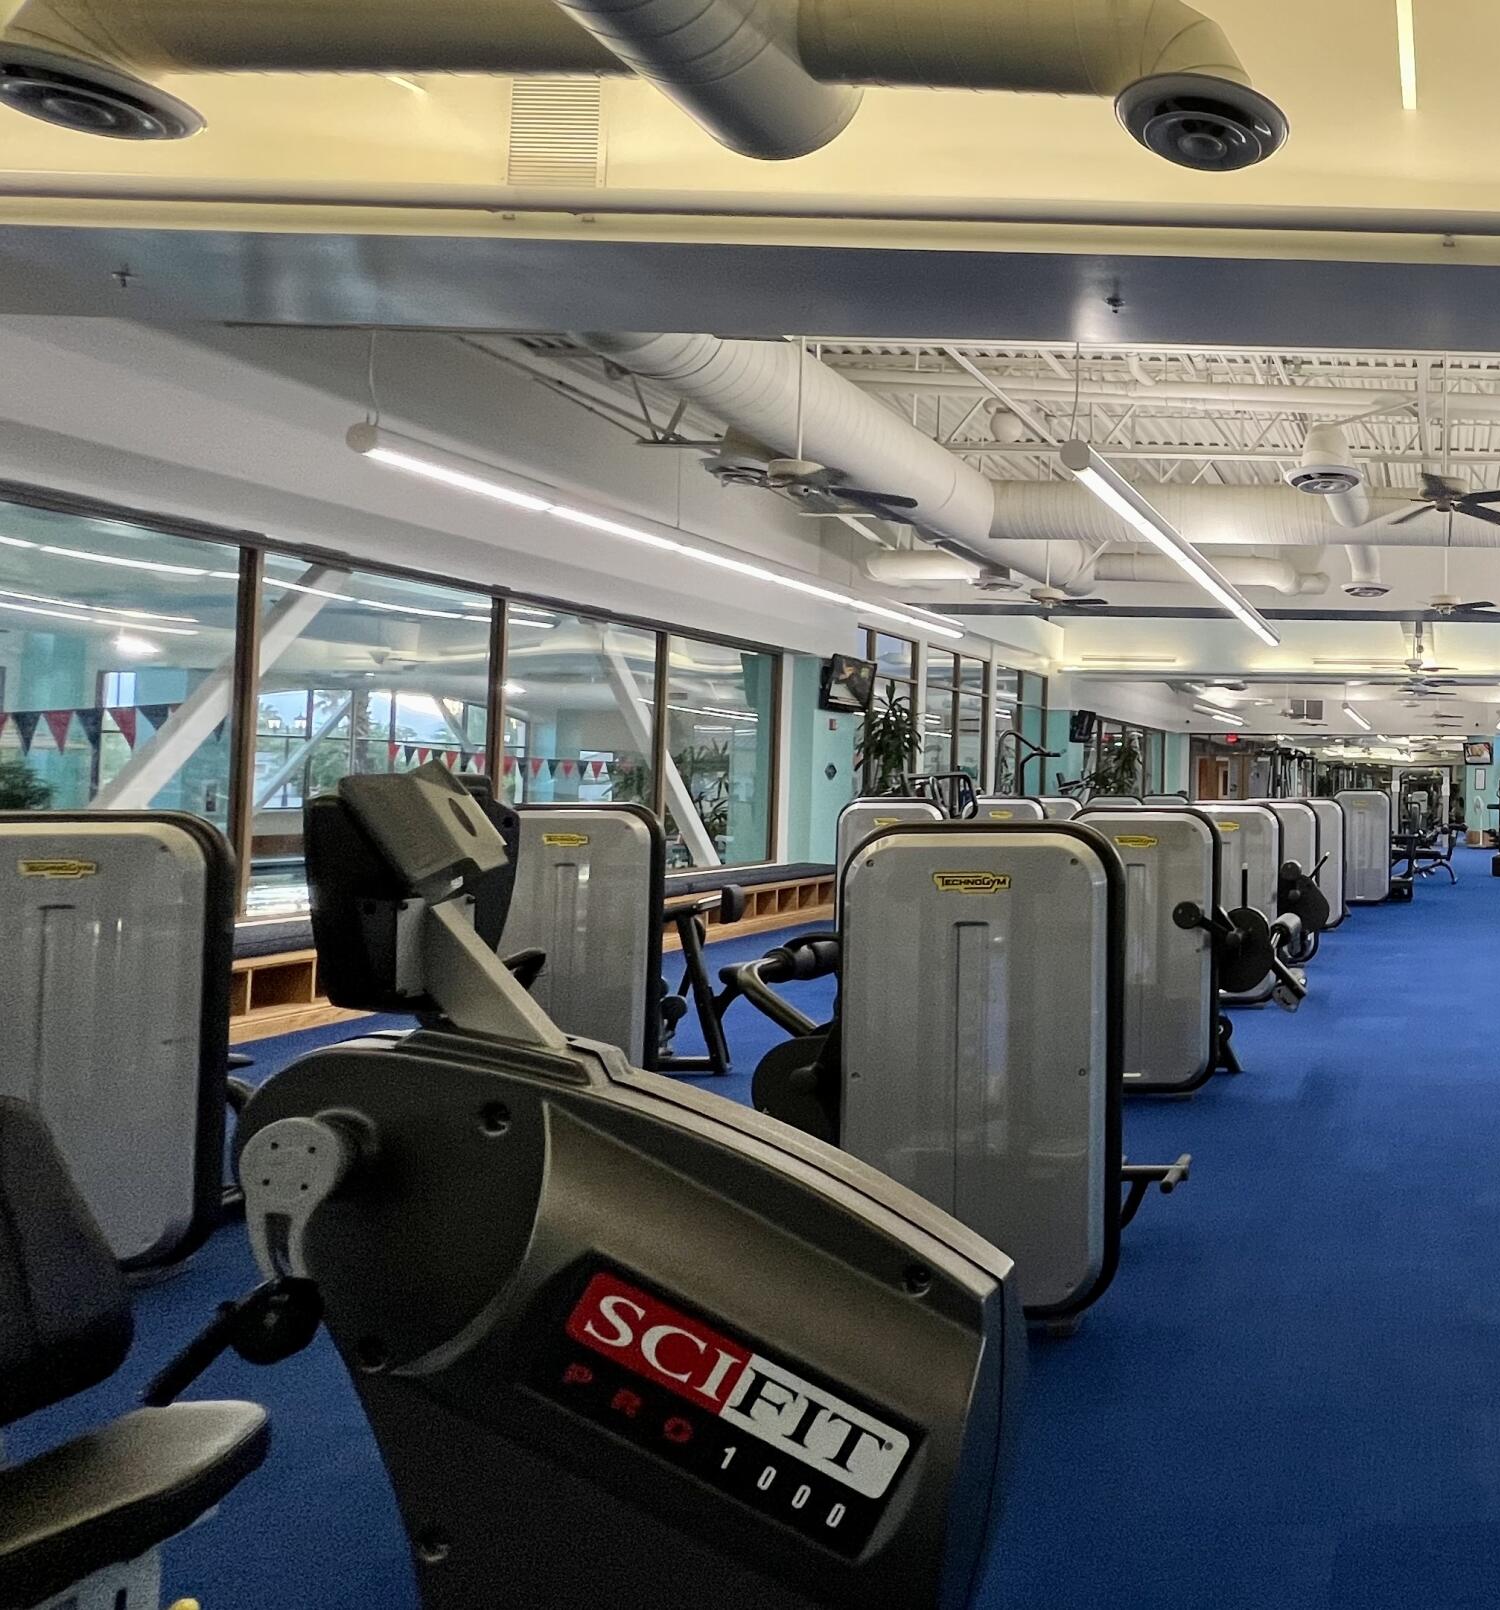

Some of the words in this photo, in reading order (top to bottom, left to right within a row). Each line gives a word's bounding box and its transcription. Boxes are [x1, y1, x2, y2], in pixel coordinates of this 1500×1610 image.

[935, 875, 1008, 889] TECHNOGYM
[562, 1361, 694, 1444] PRO
[720, 1445, 847, 1529] 1000
[583, 1294, 887, 1474] SCIFIT
